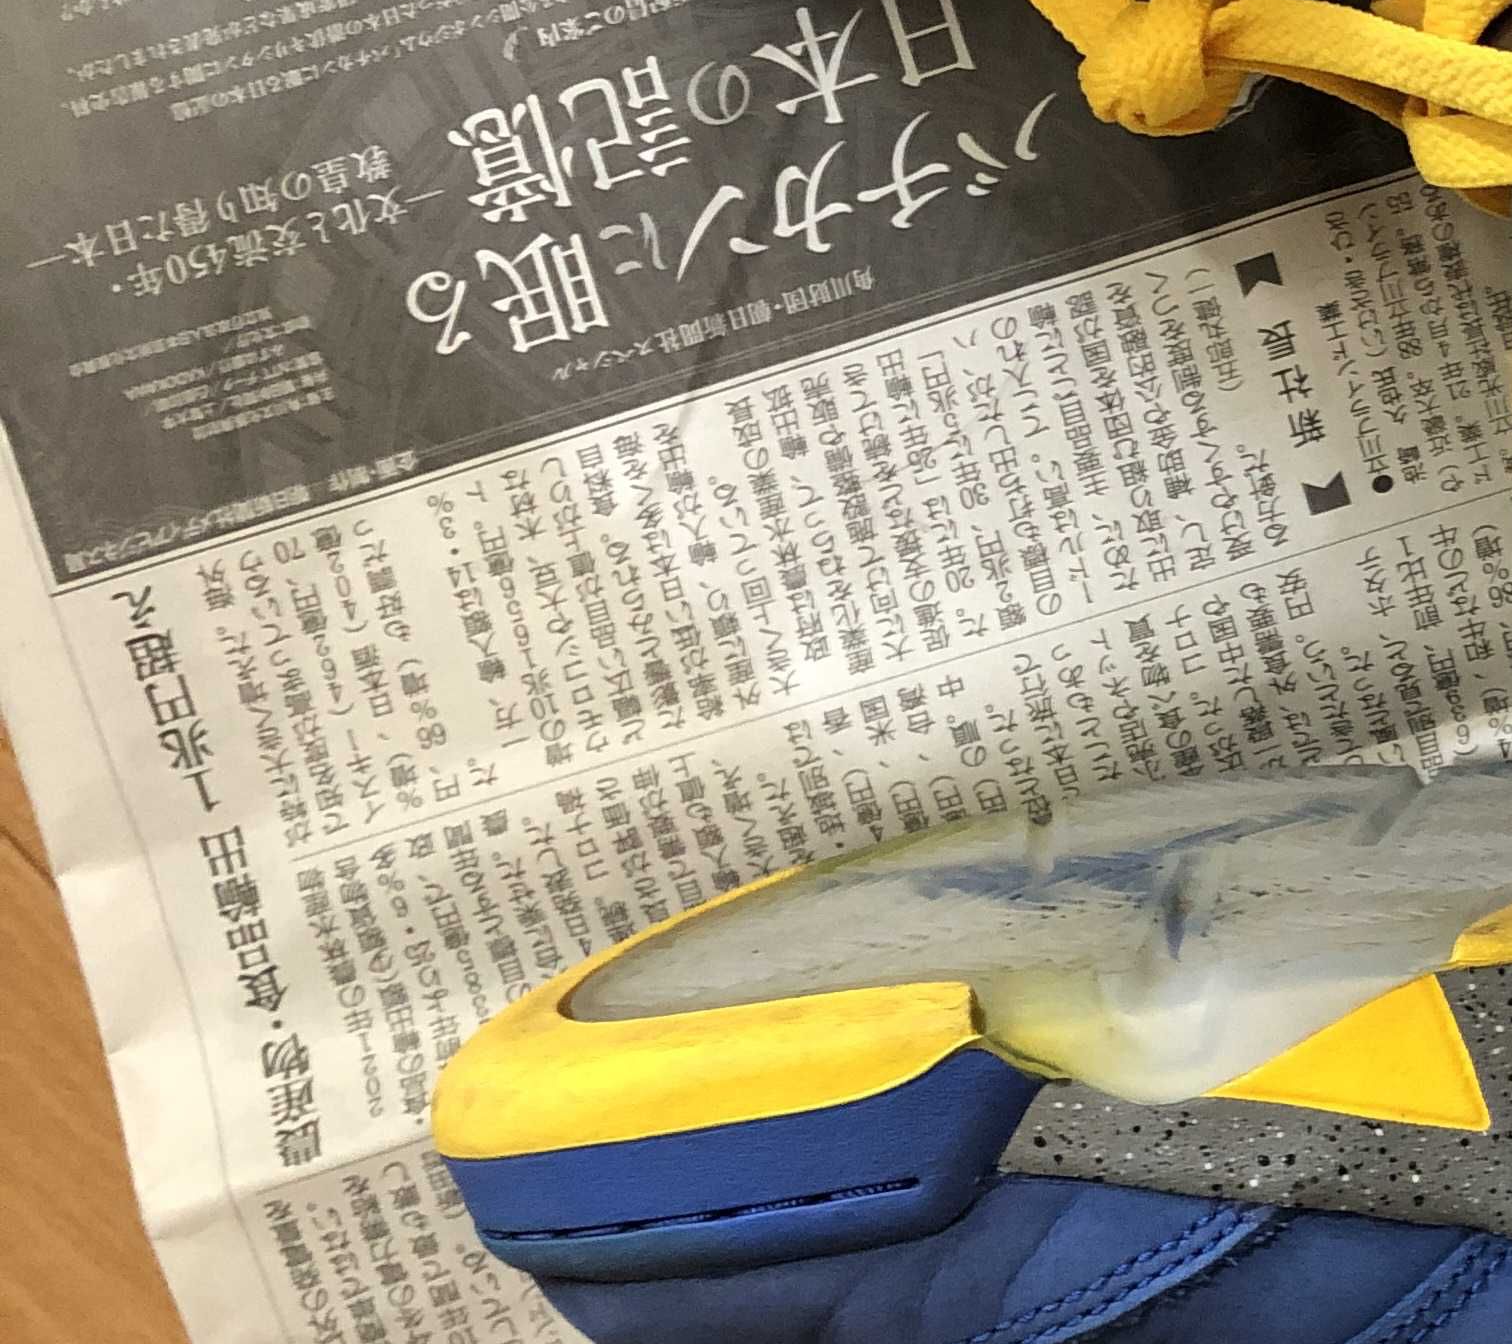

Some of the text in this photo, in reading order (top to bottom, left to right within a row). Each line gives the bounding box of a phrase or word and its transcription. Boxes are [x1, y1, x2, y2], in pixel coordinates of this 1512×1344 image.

[393, 74, 1082, 380] バチカンに眠る
[1255, 318, 1327, 449] 新社長
[1228, 437, 1294, 549] る方針だ。
[107, 581, 234, 817] 1兆円超え
[1046, 639, 1123, 786] たこともあっ
